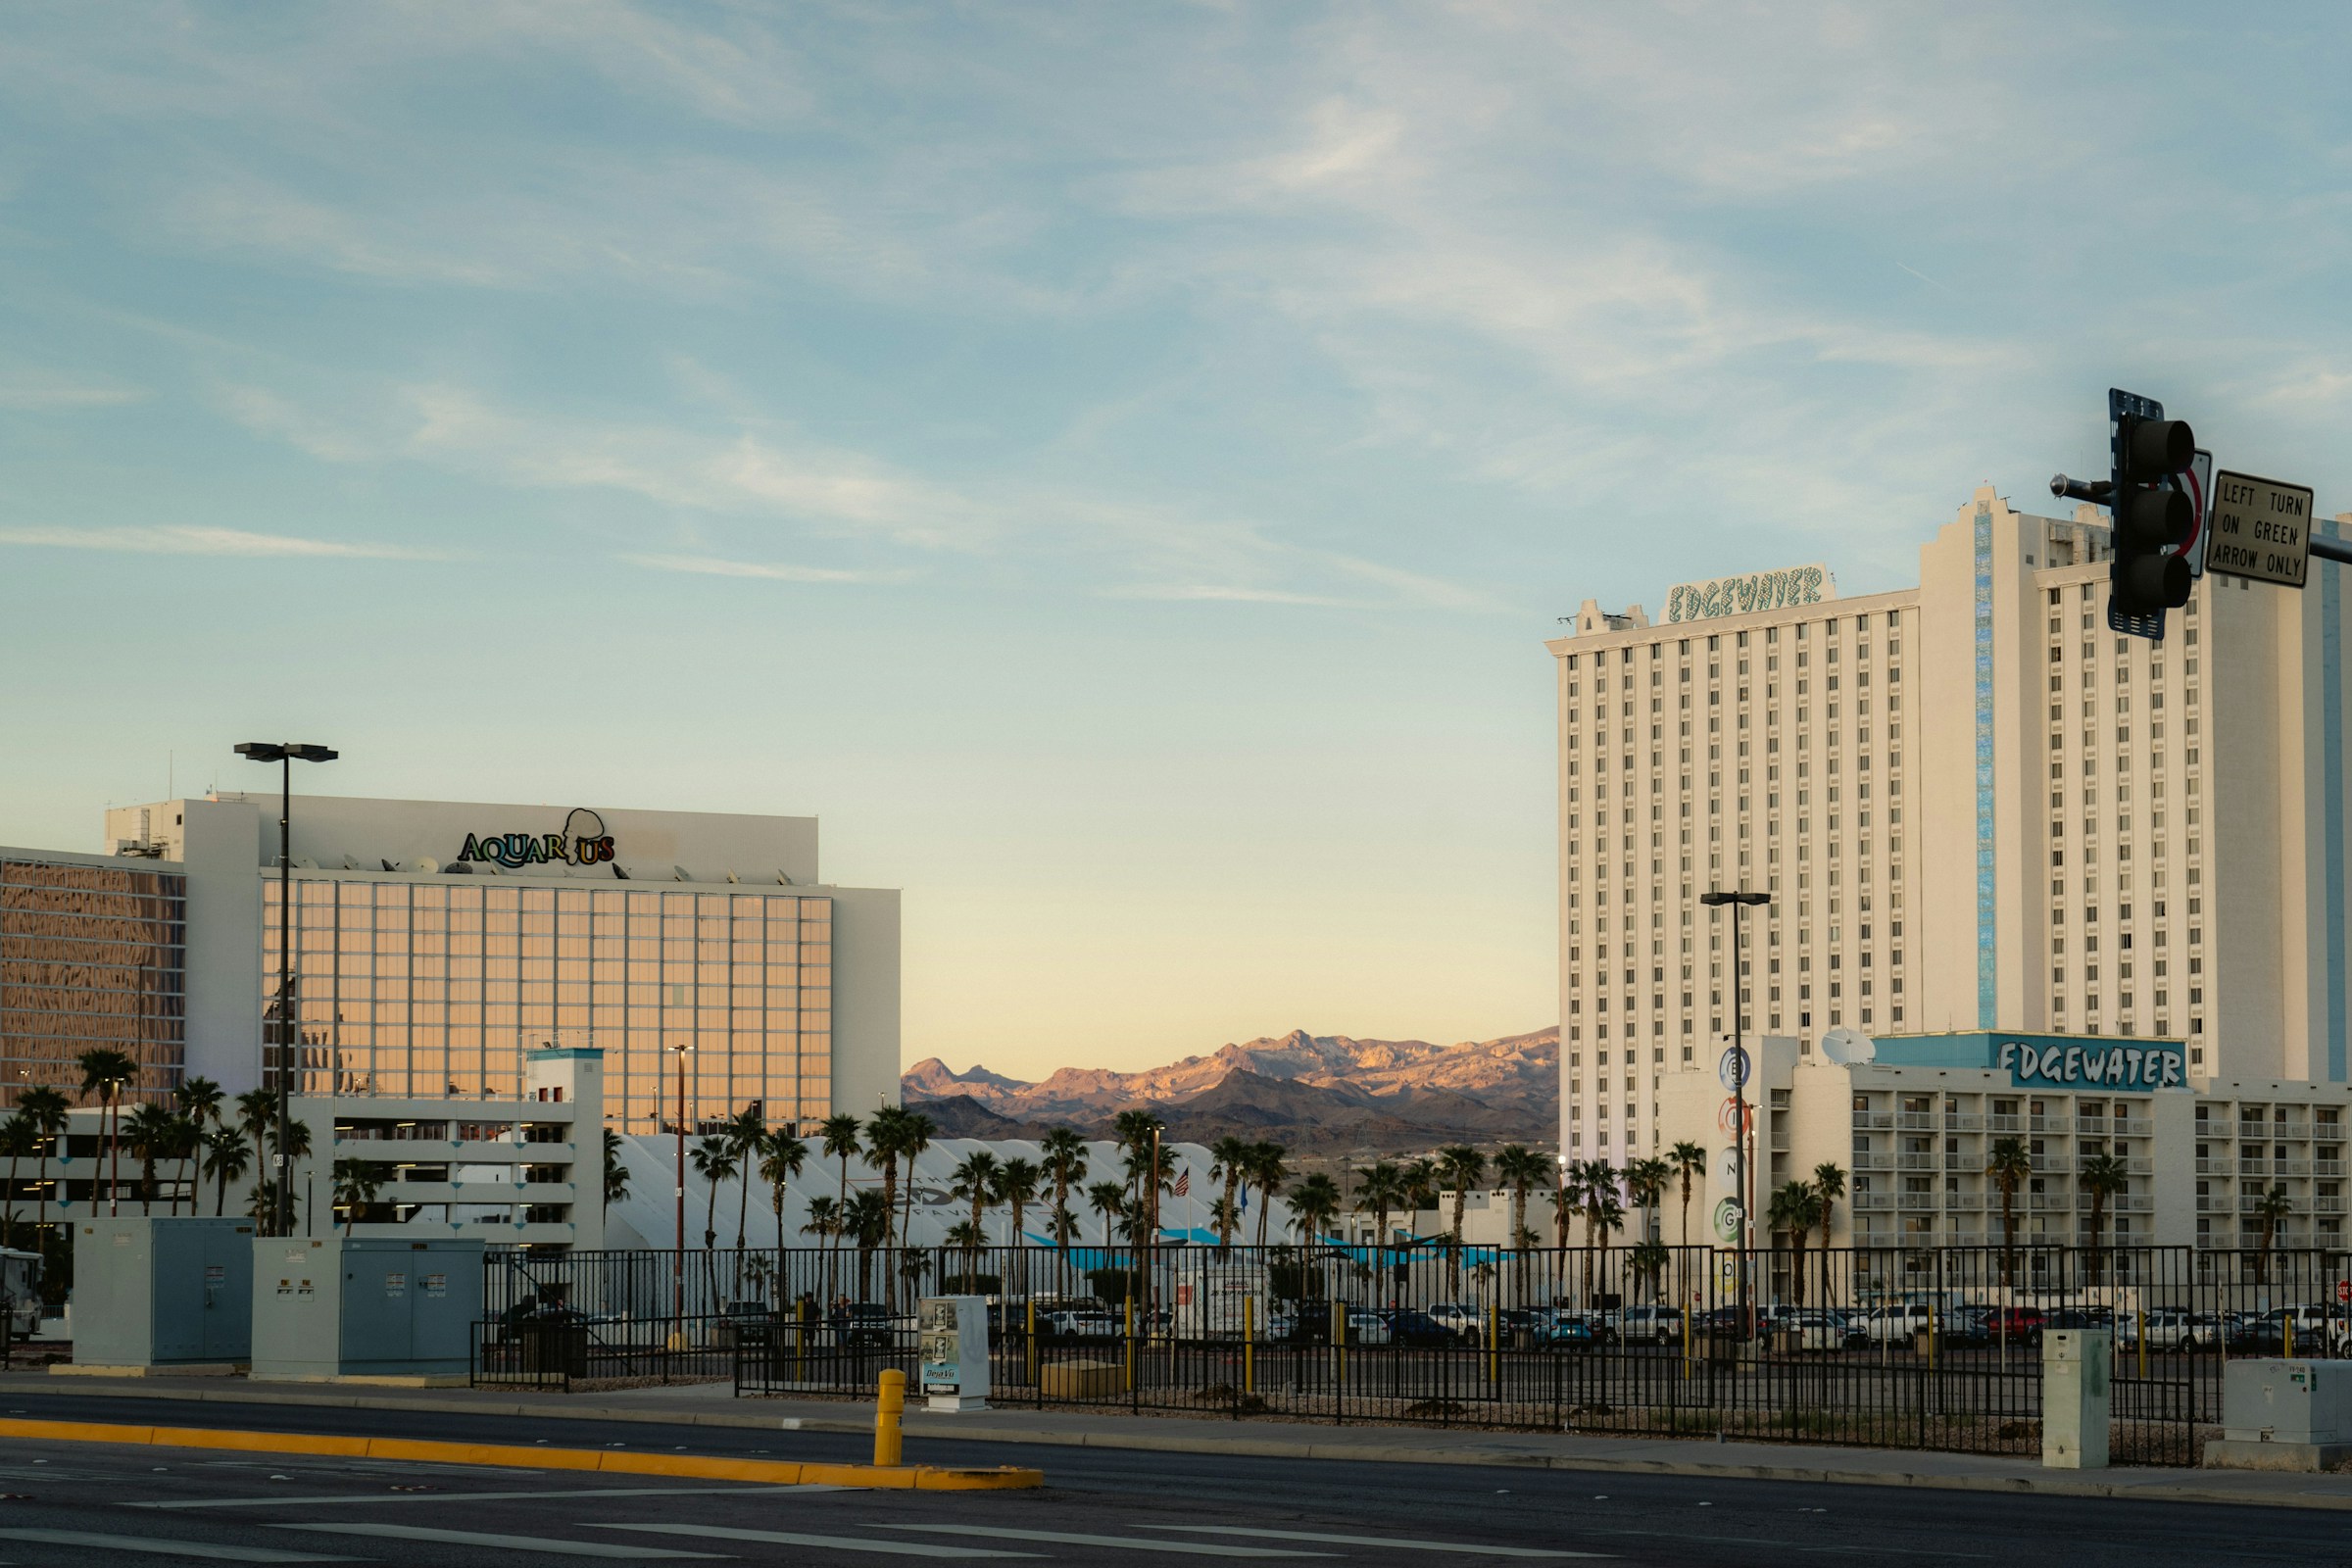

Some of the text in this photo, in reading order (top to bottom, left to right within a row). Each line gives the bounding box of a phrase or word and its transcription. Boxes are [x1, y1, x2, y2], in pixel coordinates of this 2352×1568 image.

[2224, 482, 2303, 516] LEFT TURN
[2222, 514, 2298, 546] ON GREEN
[2213, 544, 2302, 577] ARROW ONLY
[1669, 566, 1822, 623] EDGEWATER
[1999, 1042, 2181, 1085] EDGEWATER
